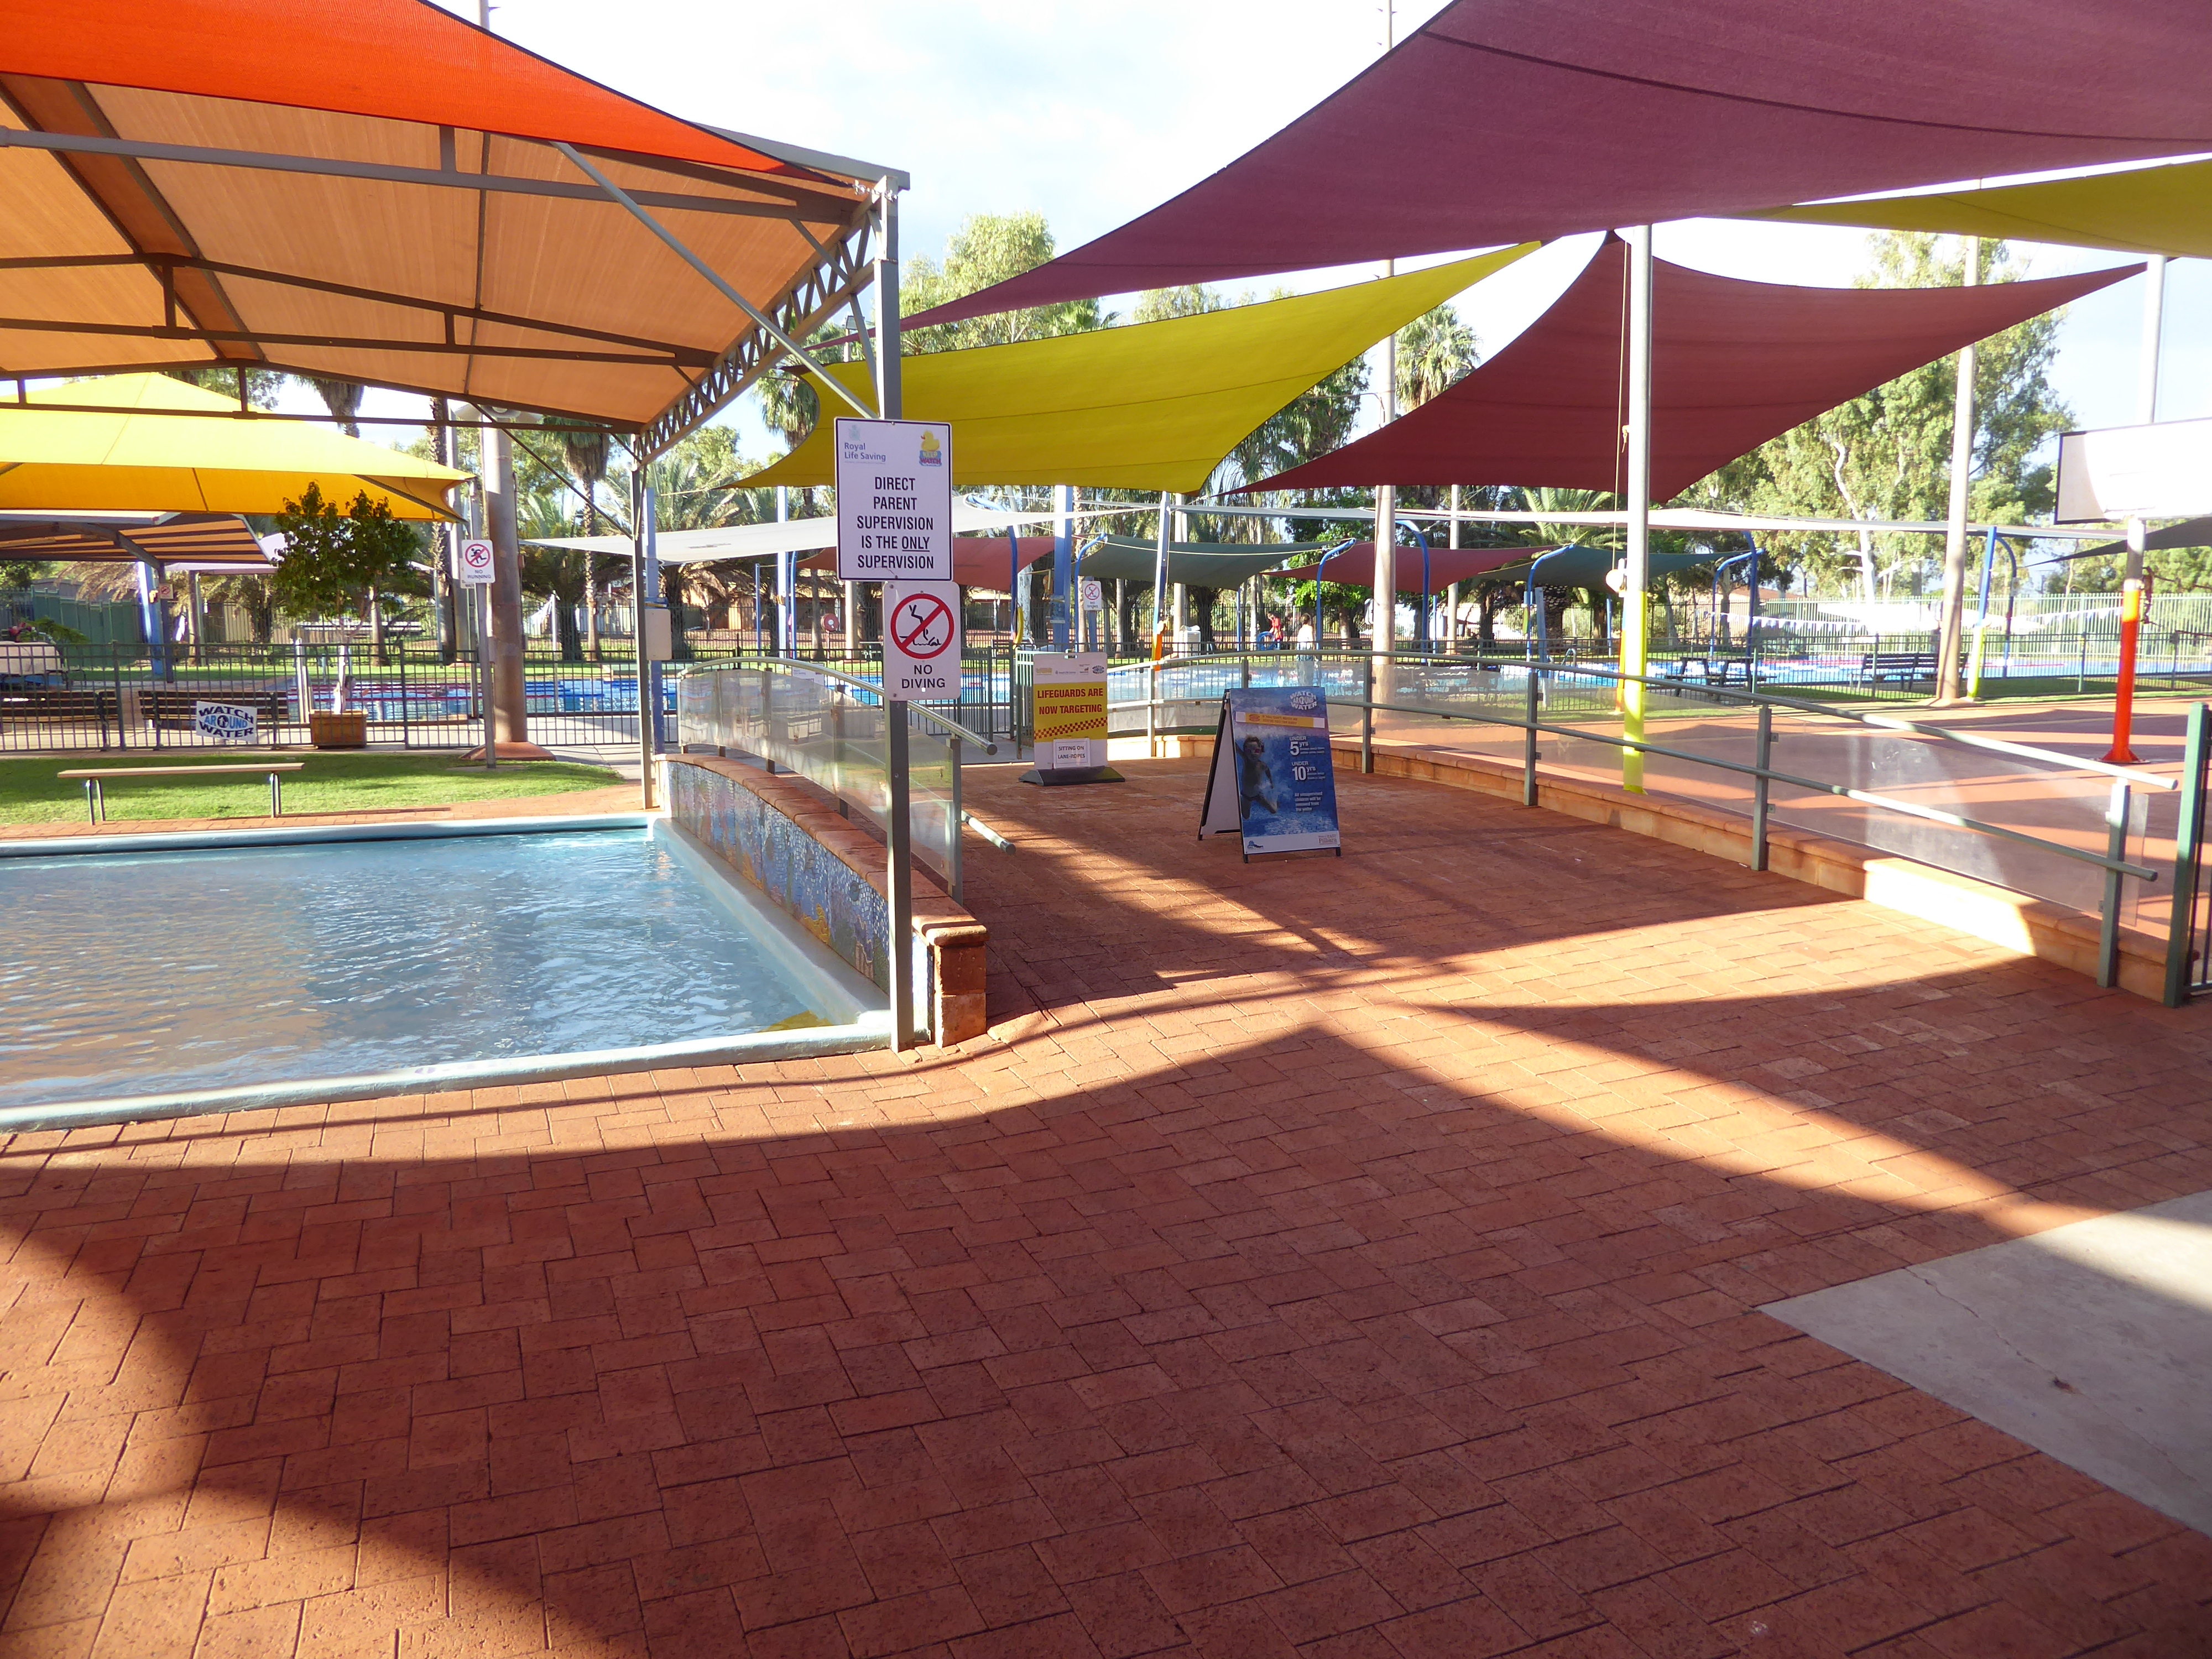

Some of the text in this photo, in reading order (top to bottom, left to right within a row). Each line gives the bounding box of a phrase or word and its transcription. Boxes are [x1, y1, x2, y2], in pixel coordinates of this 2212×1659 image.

[844, 442, 865, 451] Royal
[860, 452, 886, 462] Saving
[875, 477, 915, 491] DIRECT
[874, 497, 917, 510] PARENT
[857, 515, 933, 530] SUPERVISION
[862, 535, 930, 550] IS THE ONLY
[858, 555, 934, 568] SUPERVISION
[914, 665, 932, 675] NO
[902, 678, 945, 688] DIVING
[1037, 688, 1103, 698] LIFEGUARDS ARE
[1290, 691, 1317, 700] WATCH
[1039, 704, 1102, 714] NOW TARGETING
[1290, 701, 1317, 710] WATER
[199, 706, 254, 724] WATCH
[199, 720, 254, 737] WATER
[204, 715, 248, 729] AROUND
[1290, 741, 1300, 755] 5
[1292, 766, 1306, 780] 10
